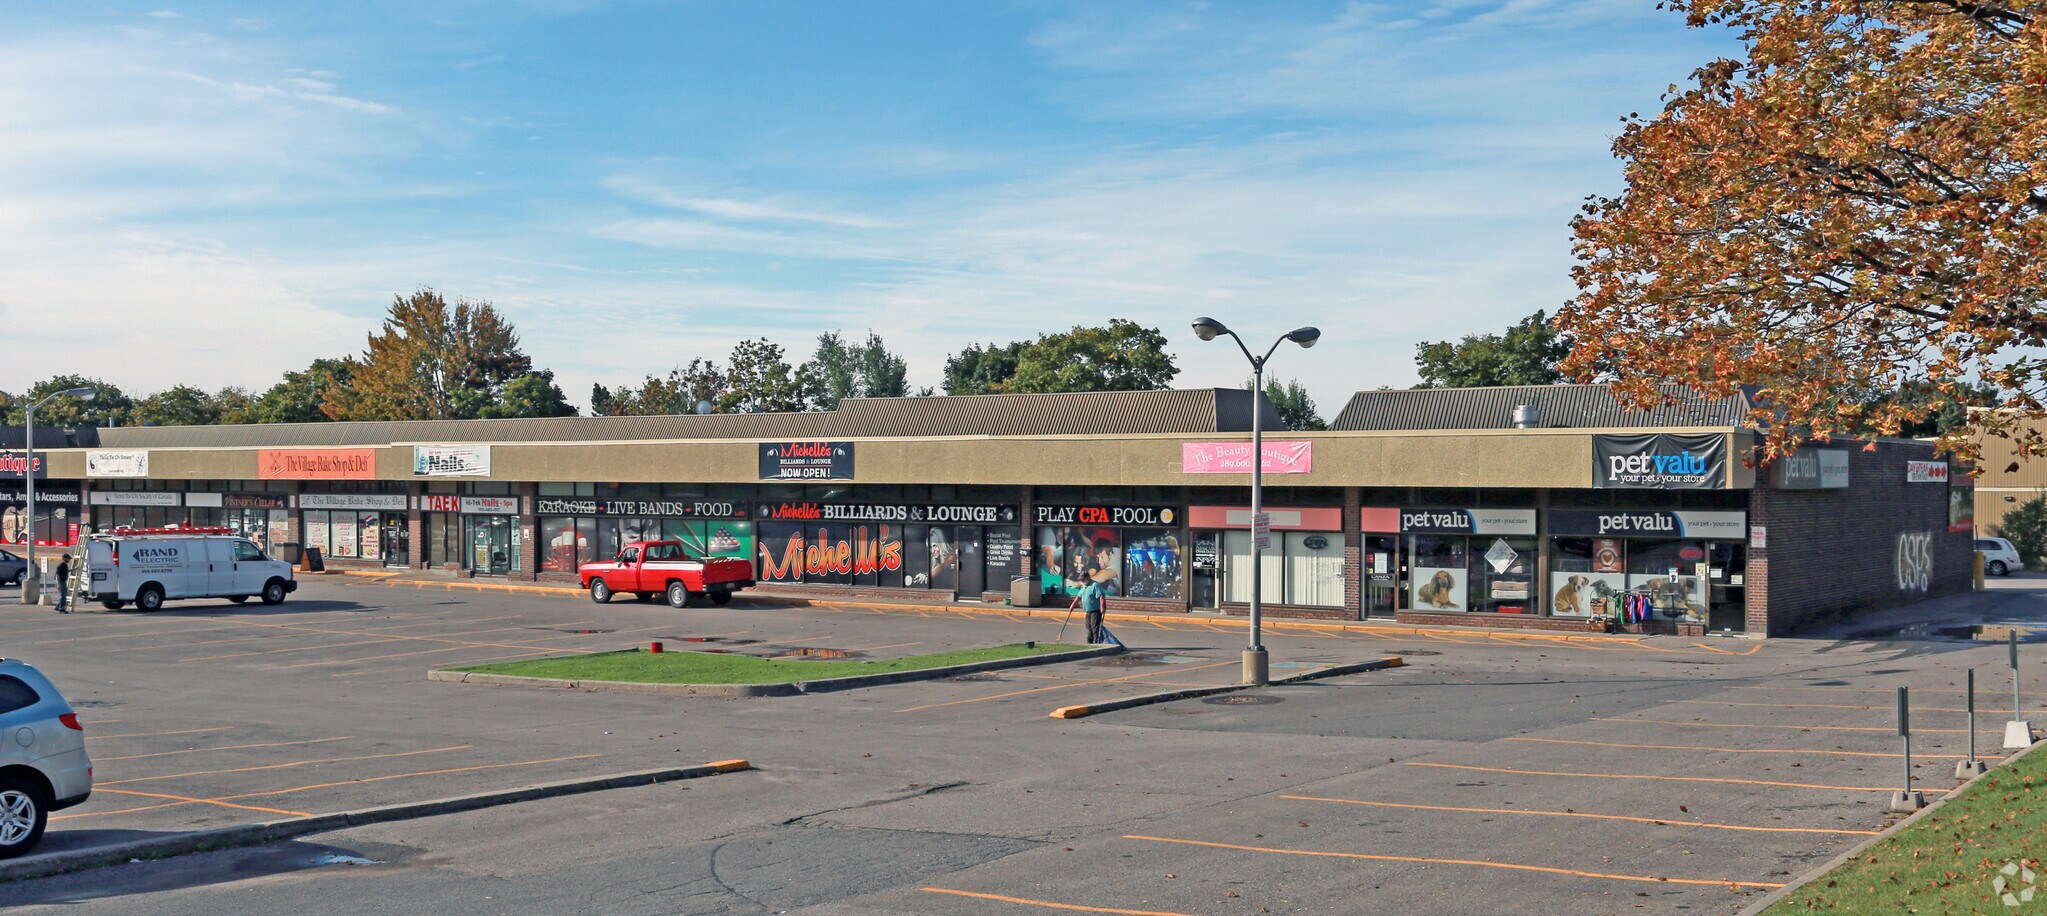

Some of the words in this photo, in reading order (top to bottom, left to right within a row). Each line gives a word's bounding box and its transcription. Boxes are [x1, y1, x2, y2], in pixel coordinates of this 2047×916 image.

[780, 442, 832, 457] Michelle's
[1193, 450, 1214, 465] The
[1215, 445, 1251, 458] Beauty
[1261, 448, 1298, 466] outique
[286, 456, 298, 472] The
[298, 456, 317, 477] Village
[317, 456, 332, 471] Bake
[332, 456, 348, 477] Shop
[348, 456, 355, 471] &
[355, 456, 368, 471] Deli
[428, 454, 465, 471] Nails
[1609, 451, 1651, 481] pet
[1651, 450, 1707, 475] valu
[1785, 454, 1800, 485] pet
[1800, 452, 1817, 478] valu
[780, 468, 801, 478] NOW
[803, 468, 831, 478] OPEN!
[1620, 474, 1640, 484] your
[1641, 474, 1656, 483] pet
[1661, 475, 1682, 483] your
[1683, 474, 1706, 483] store
[35, 492, 41, 502] &
[41, 492, 79, 502] Accessories
[312, 496, 324, 505] The
[325, 495, 346, 508] Village
[347, 495, 364, 506] Bake
[366, 496, 383, 508] Shop
[392, 495, 405, 506] Deli
[427, 495, 460, 512] TAEK
[481, 498, 500, 507] Nails
[503, 500, 513, 508] Spa
[538, 499, 596, 514] KARAOKE
[606, 501, 636, 514] LIVE
[639, 501, 683, 515] BANDS
[694, 502, 733, 516] FOOD
[772, 502, 821, 519] Michelle's
[823, 504, 907, 520] BILLIARDS
[910, 506, 924, 520] &
[927, 506, 997, 521] LOUNGE
[1037, 507, 1076, 522] PLAY
[1079, 507, 1110, 523] CPA
[1113, 508, 1157, 523] POOL
[1402, 511, 1431, 531] pet
[1431, 511, 1470, 528] valu
[1598, 512, 1630, 534] pet
[1630, 512, 1674, 531] valu
[1700, 519, 1710, 527] pet
[140, 548, 178, 557] RAND
[759, 523, 902, 581] Michelle's
